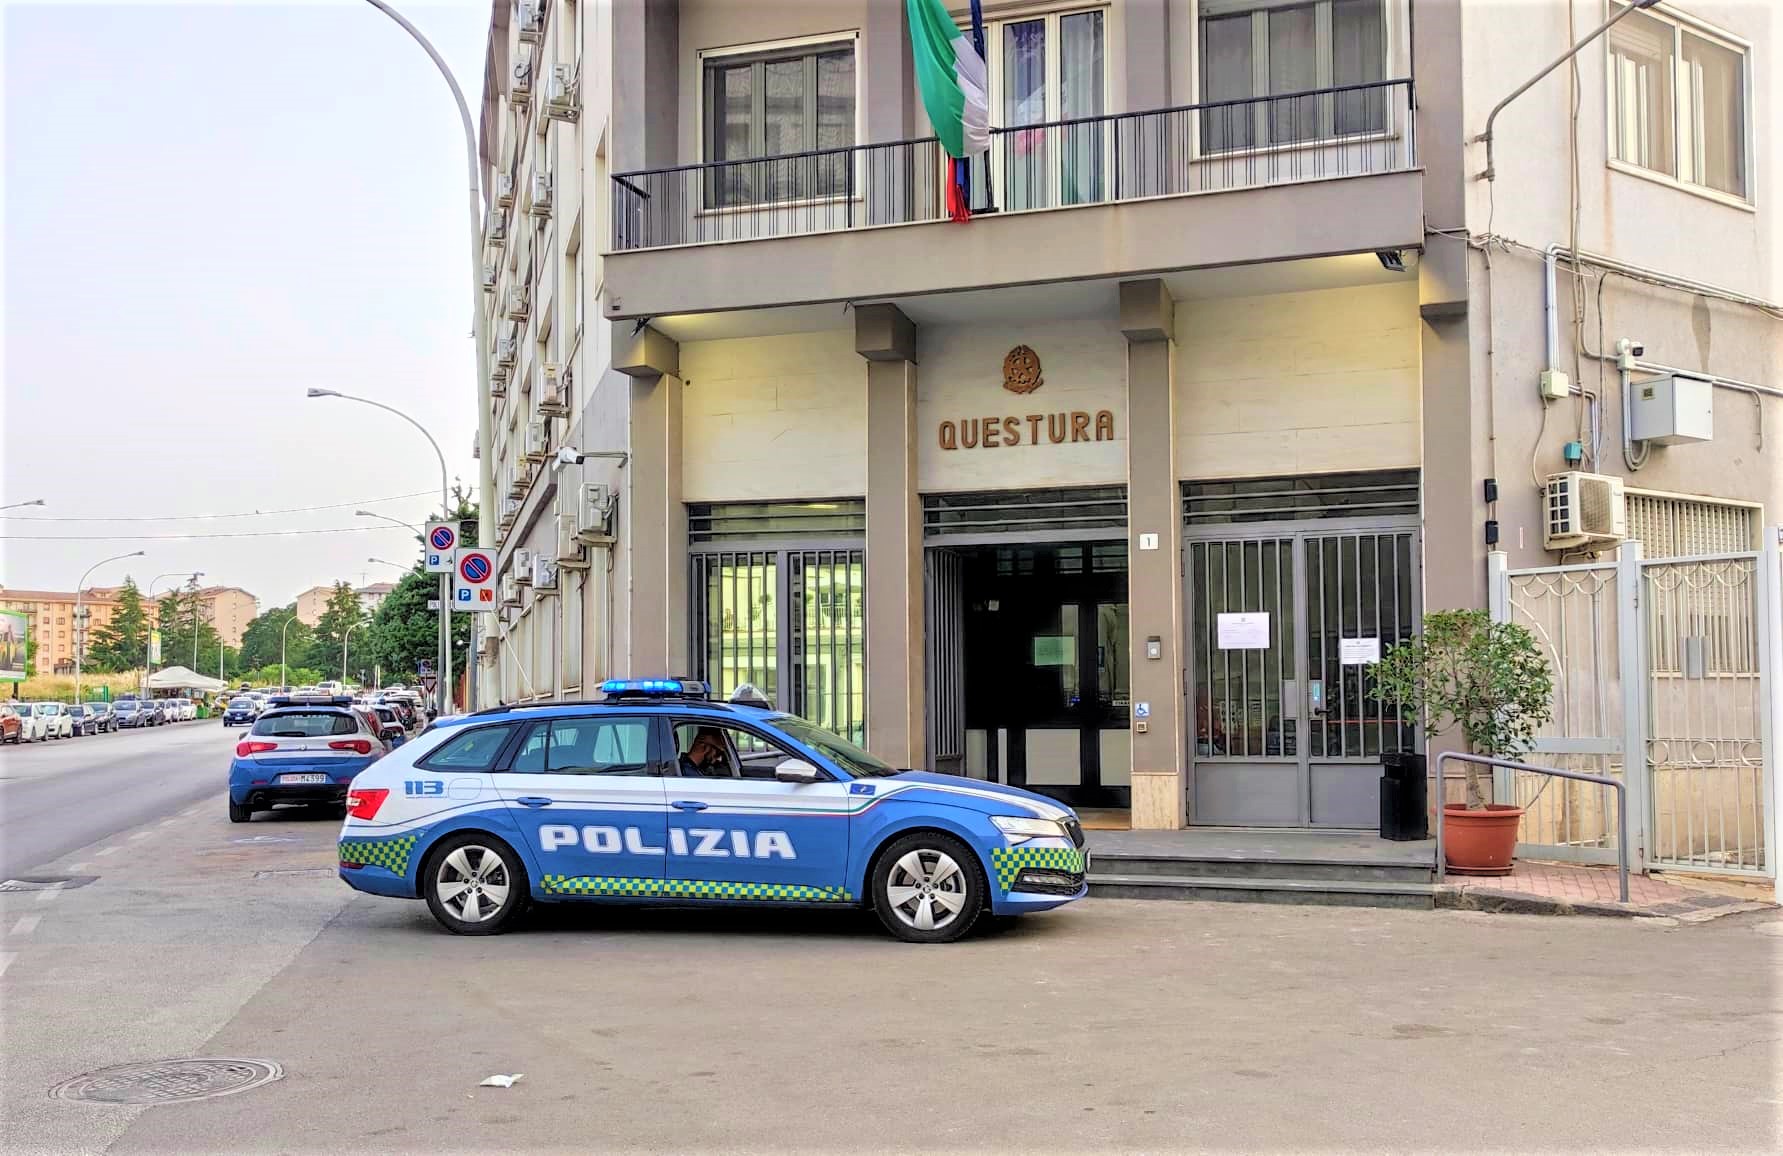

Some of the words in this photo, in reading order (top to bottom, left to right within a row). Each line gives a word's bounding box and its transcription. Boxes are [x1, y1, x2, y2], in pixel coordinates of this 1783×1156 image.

[938, 410, 1114, 450] QUESTURA
[430, 556, 438, 565] P
[461, 590, 470, 600] P
[404, 781, 444, 795] 113
[539, 825, 797, 859] POLIZIA
